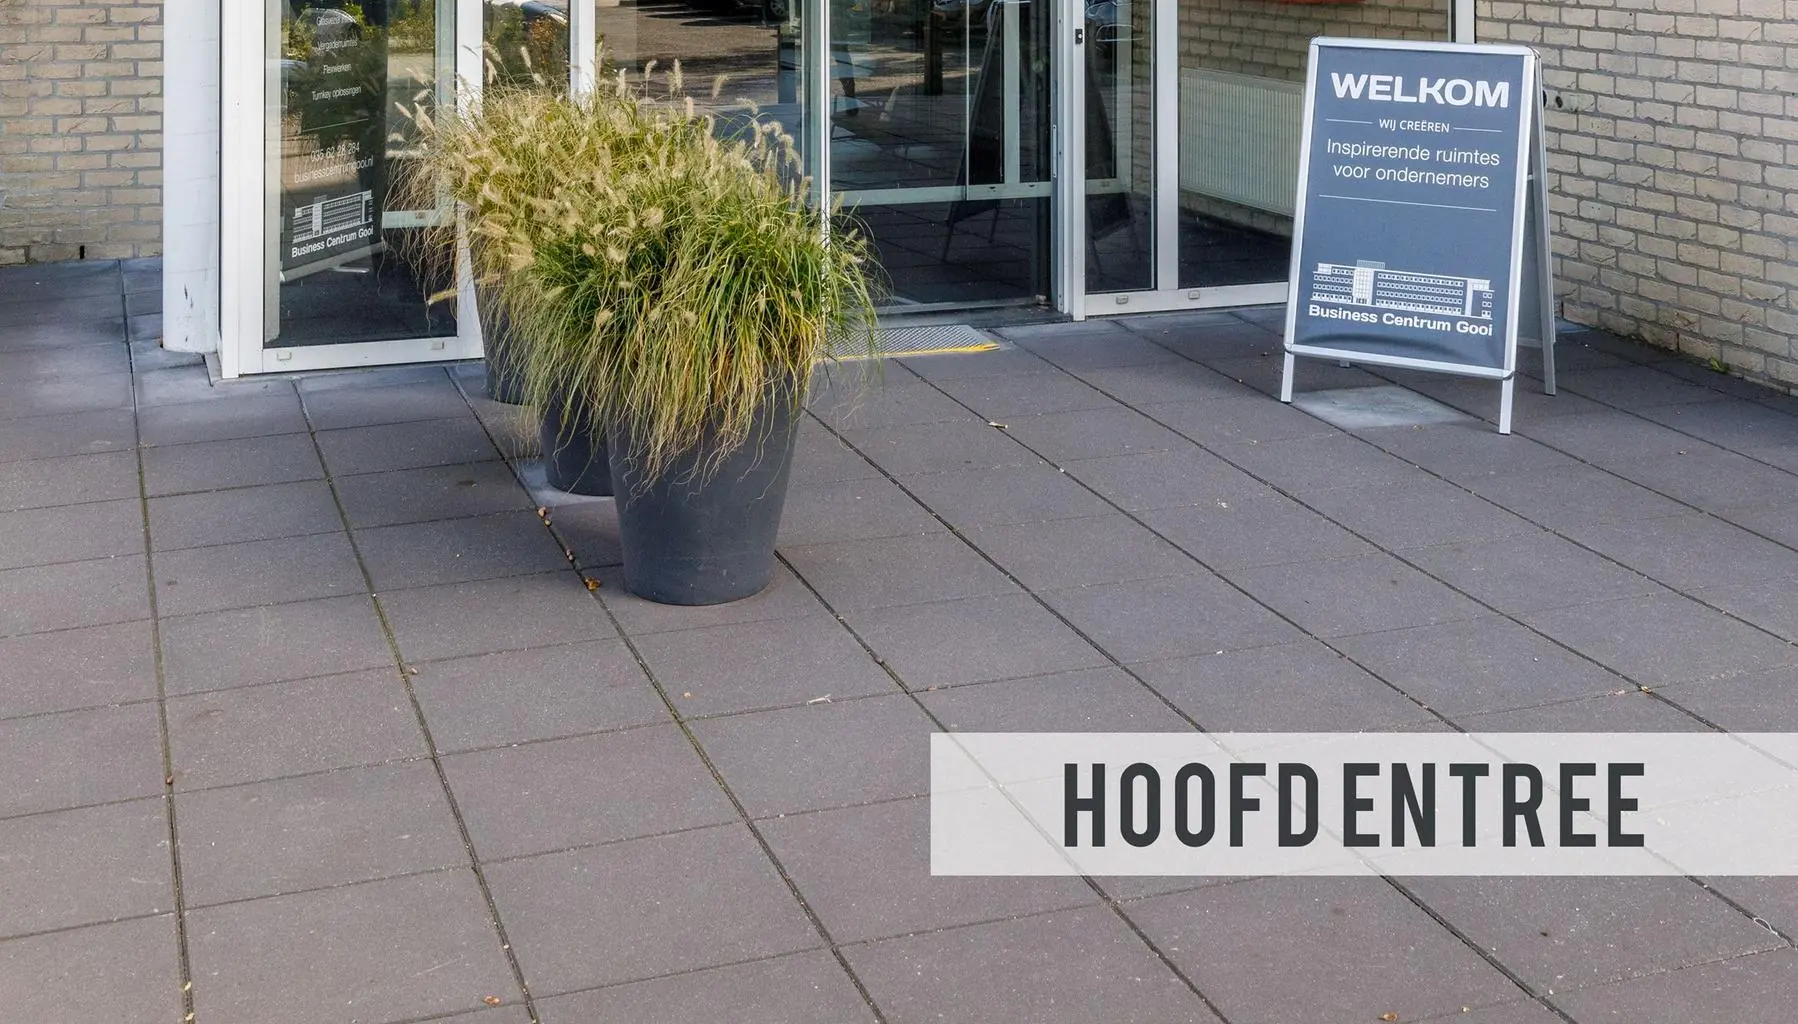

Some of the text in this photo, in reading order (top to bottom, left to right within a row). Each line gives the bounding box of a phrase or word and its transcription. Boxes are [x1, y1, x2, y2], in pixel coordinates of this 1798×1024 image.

[1330, 72, 1510, 108] WELKOM
[1378, 118, 1450, 133] WIJ CREËREN
[1327, 138, 1500, 166] Inspirerende ruimtes
[1333, 164, 1489, 188] voor ondernemers
[292, 225, 374, 258] Business Centrum Gooi
[1308, 304, 1493, 337] Business Centrum Gooi
